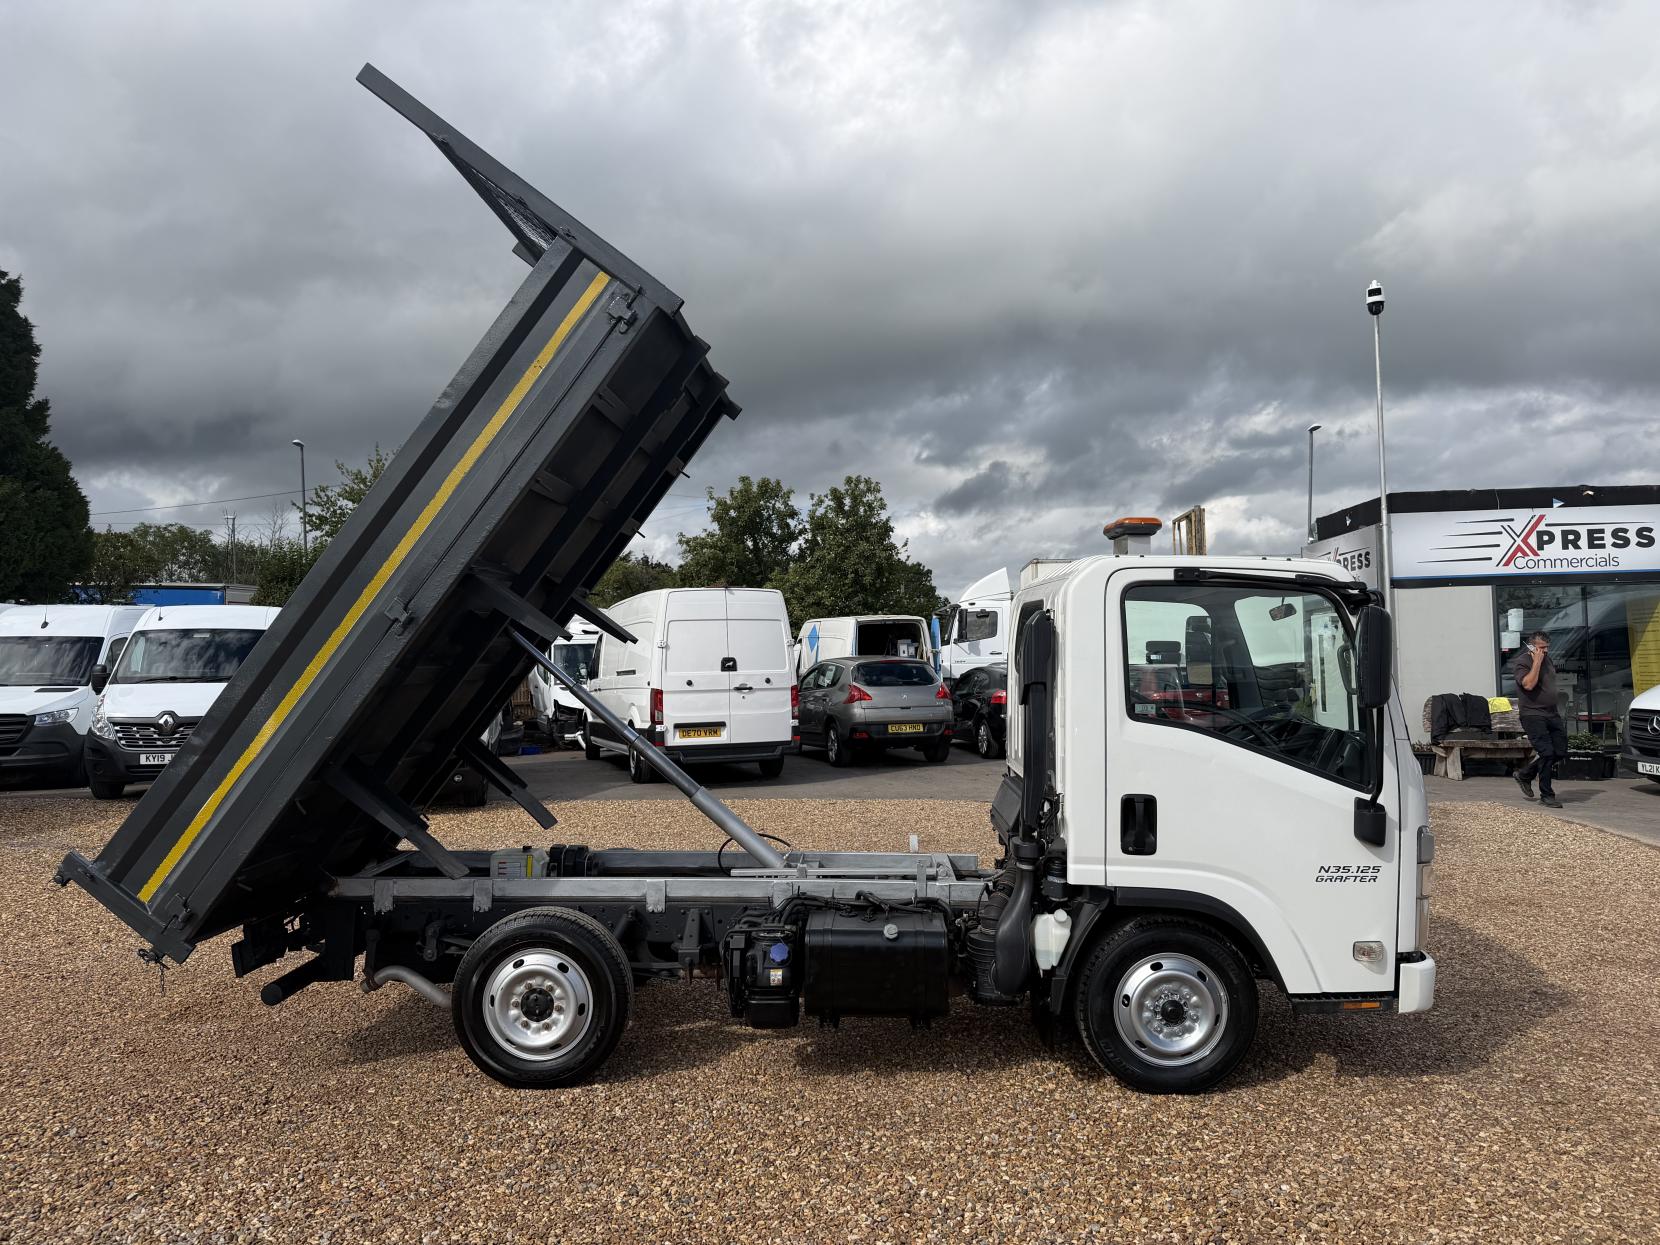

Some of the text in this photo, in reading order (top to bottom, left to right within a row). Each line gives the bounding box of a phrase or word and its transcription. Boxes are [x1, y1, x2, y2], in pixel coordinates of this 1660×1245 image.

[1496, 514, 1656, 566] XPRESS
[1513, 553, 1620, 569] Commercials
[682, 728, 718, 737] DE70 VRM
[145, 754, 166, 763] KY19
[1641, 763, 1655, 773] YL21
[1318, 865, 1382, 874] N35.125
[1315, 875, 1378, 883] GRAFTER
